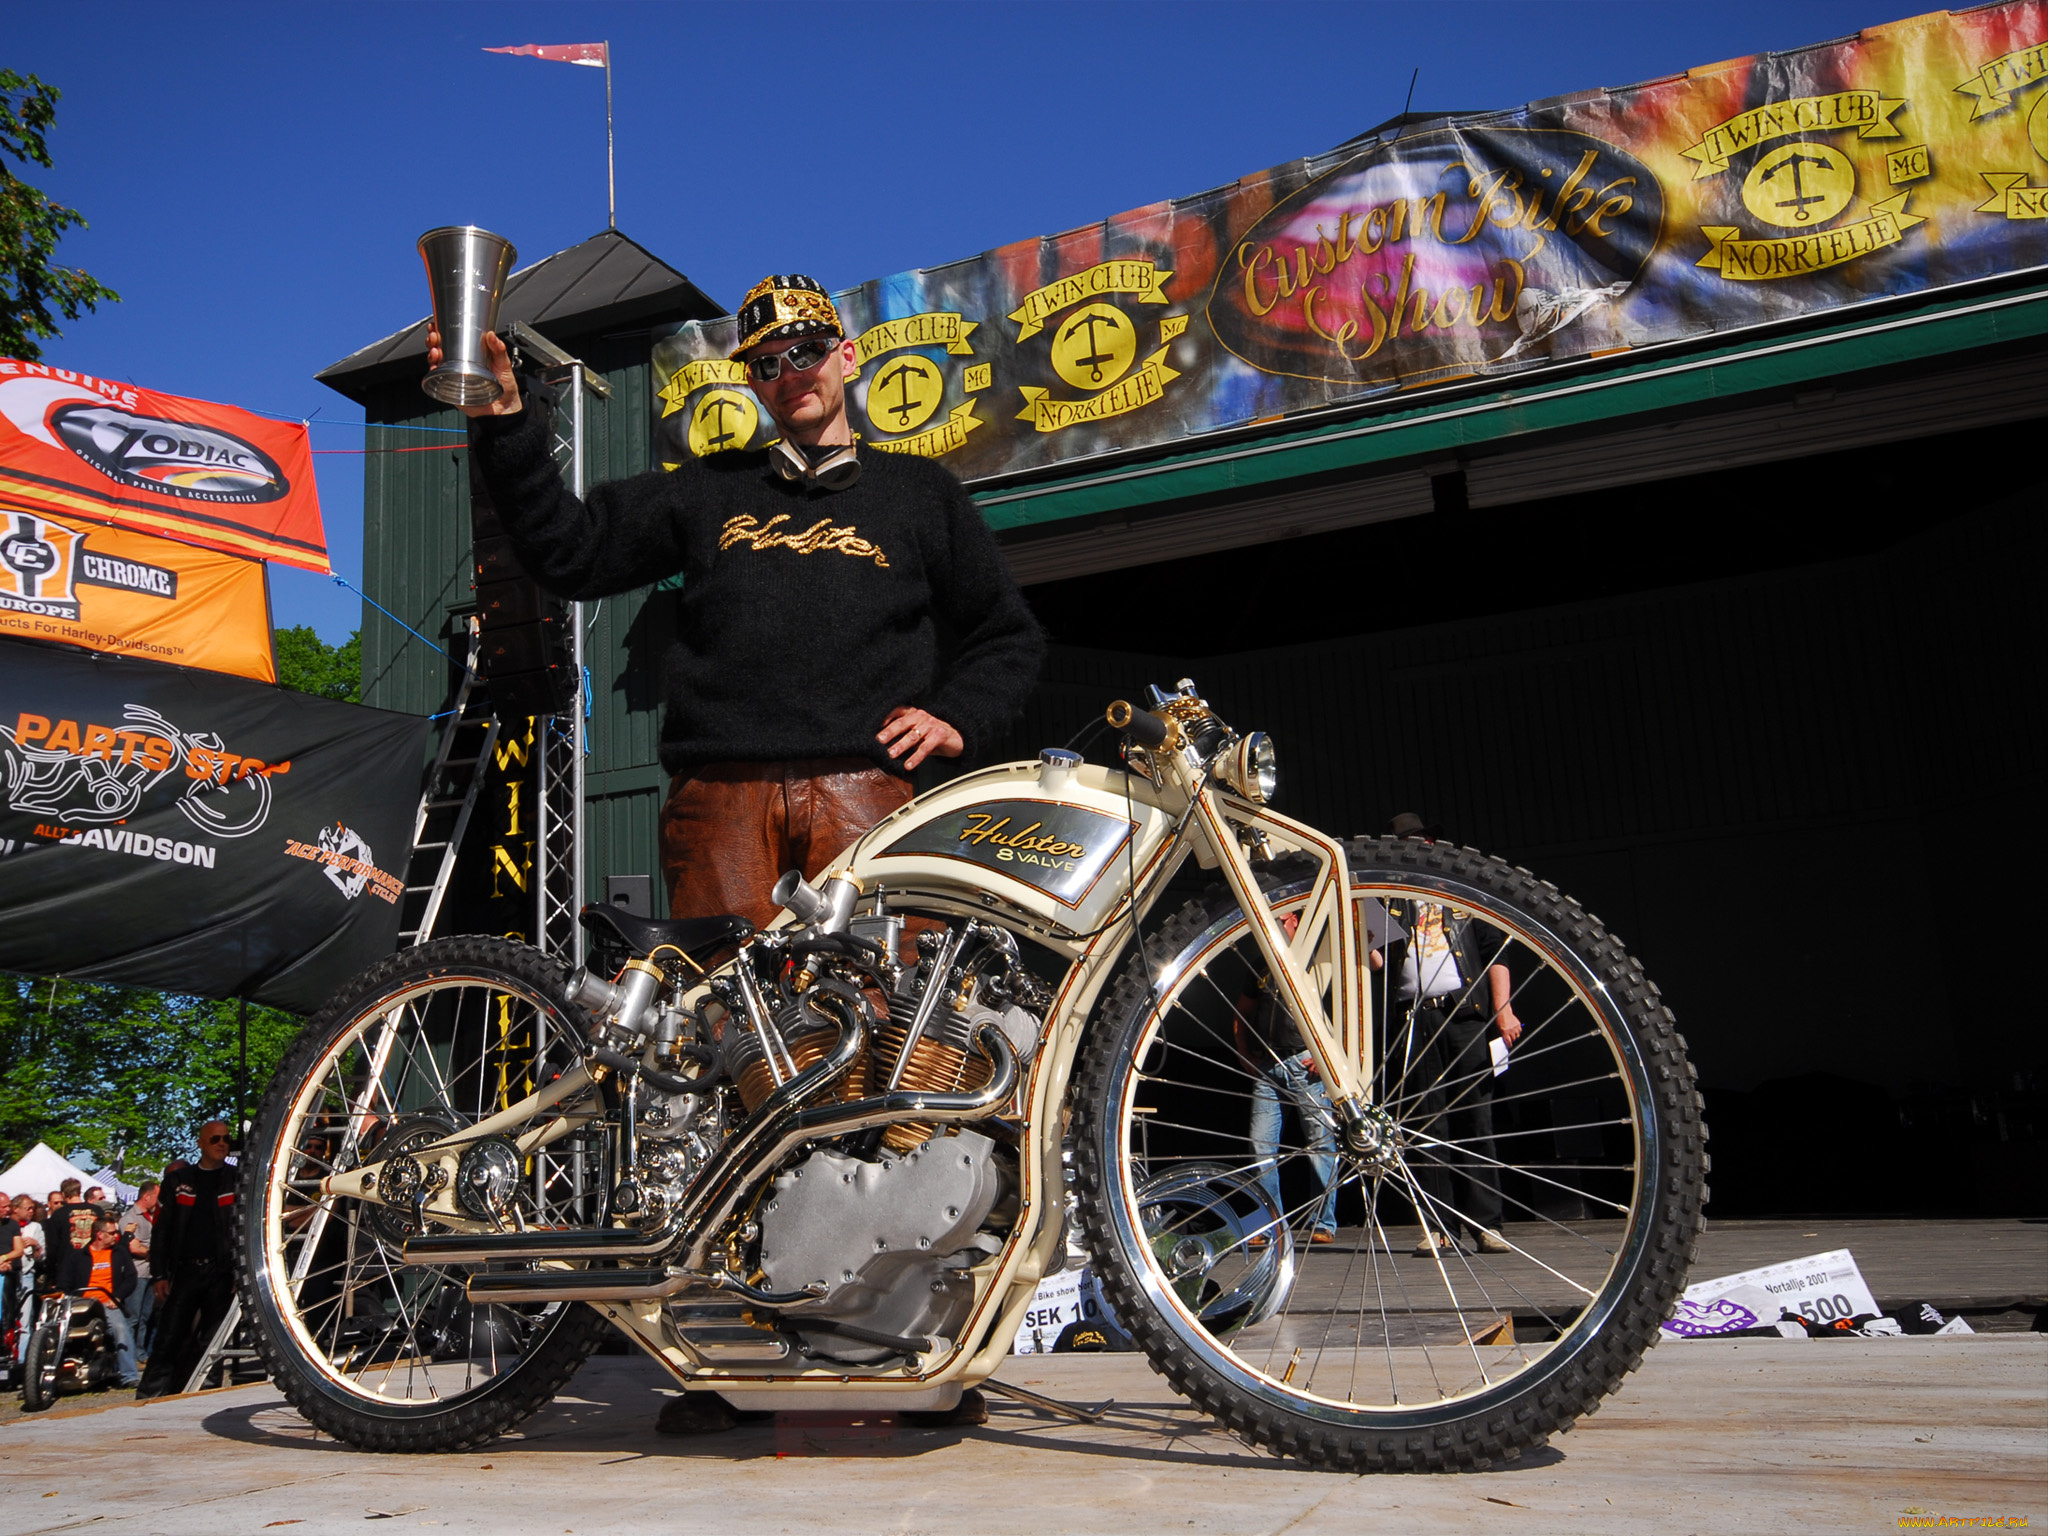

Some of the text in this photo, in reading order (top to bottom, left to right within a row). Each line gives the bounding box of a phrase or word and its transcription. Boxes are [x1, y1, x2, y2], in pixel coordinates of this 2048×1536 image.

[1984, 46, 2048, 90] TWI
[1706, 94, 1876, 156] TWIN CLUB
[1892, 152, 1927, 177] MC
[1238, 150, 1636, 316] Custom Bike
[1727, 219, 1895, 276] NORRTELJE
[1026, 265, 1150, 317] TWIN CLUB
[1303, 233, 1544, 360] Show
[855, 316, 958, 358] WIN CLUB
[1163, 319, 1186, 337] MC
[673, 363, 721, 395] TWIN
[967, 367, 989, 388] MC
[1040, 370, 1158, 427] NORRTELJE
[107, 421, 250, 470] ZODIAC
[76, 448, 126, 484] ORIGINAL
[133, 481, 168, 494] PARTS
[188, 491, 257, 502] ACCESSORIES
[83, 554, 171, 596] CHROME
[34, 621, 58, 634] For
[14, 712, 173, 772] PARTS
[33, 823, 70, 839] ALLT
[959, 813, 1086, 859] Hulster
[317, 850, 405, 896] PERFORMANCE
[996, 848, 1075, 872] 8 VALVE
[1038, 1291, 1055, 1301] Bike
[1056, 1286, 1075, 1296] show
[1806, 1272, 1828, 1286] 2007
[1025, 1306, 1062, 1328] SEK
